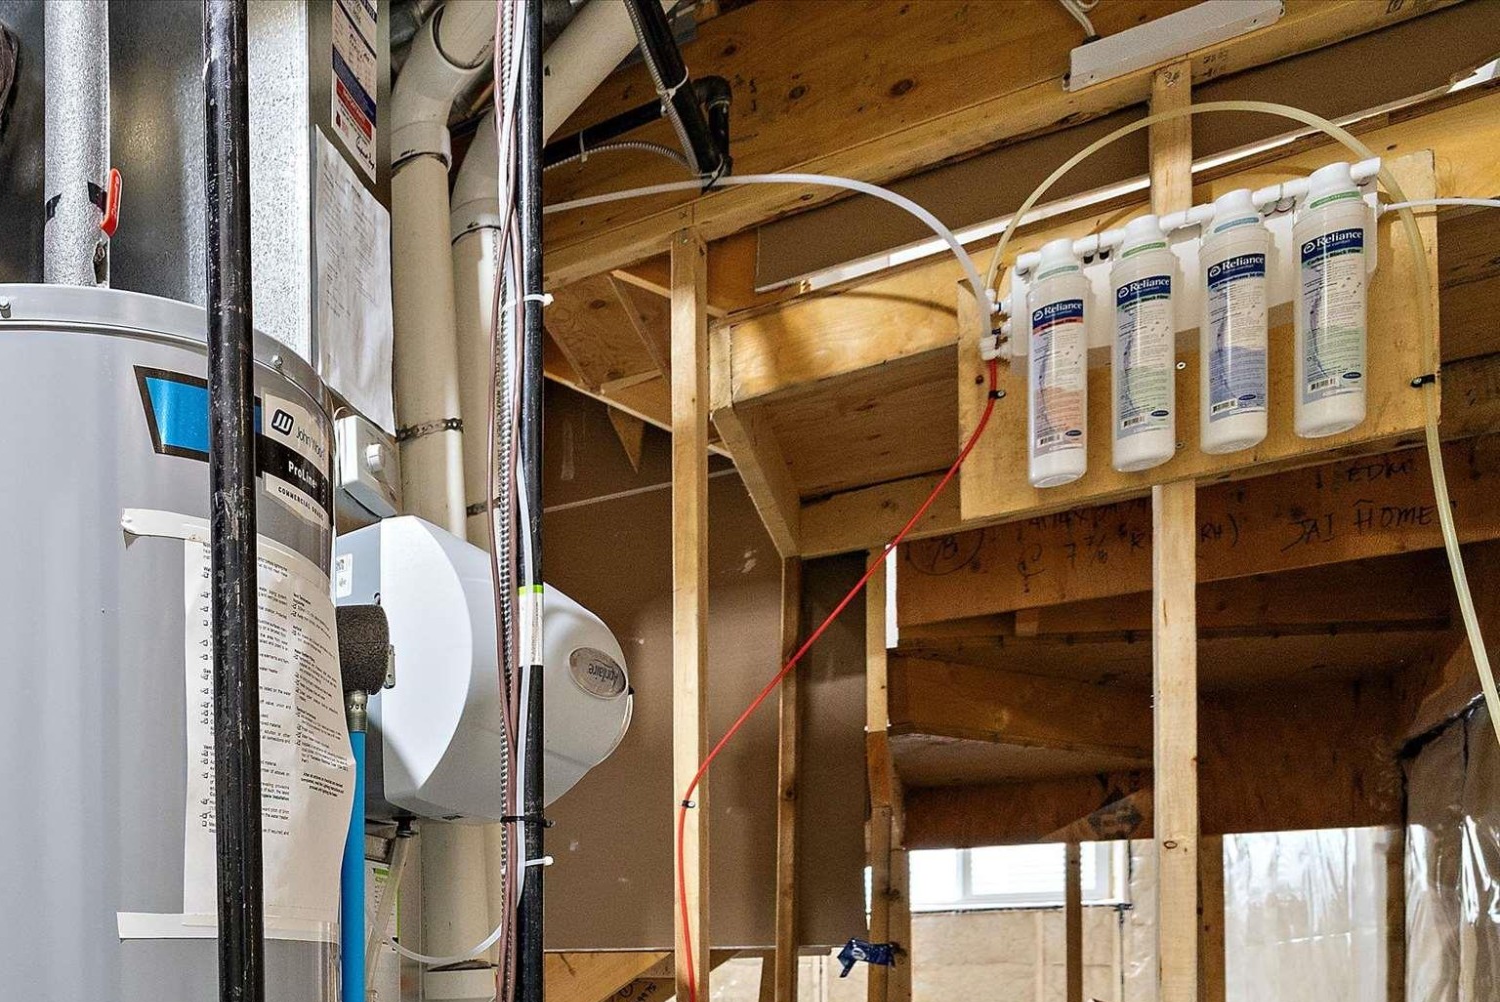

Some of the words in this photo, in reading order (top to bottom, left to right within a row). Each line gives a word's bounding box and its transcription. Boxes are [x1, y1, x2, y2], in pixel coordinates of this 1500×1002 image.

[1316, 231, 1363, 246] Reliance
[1222, 256, 1264, 270] Reliance
[1129, 275, 1170, 292] Reliance
[1044, 302, 1082, 315] Reliance
[288, 460, 317, 488] ProLine
[278, 486, 310, 510] COMMERCIAL
